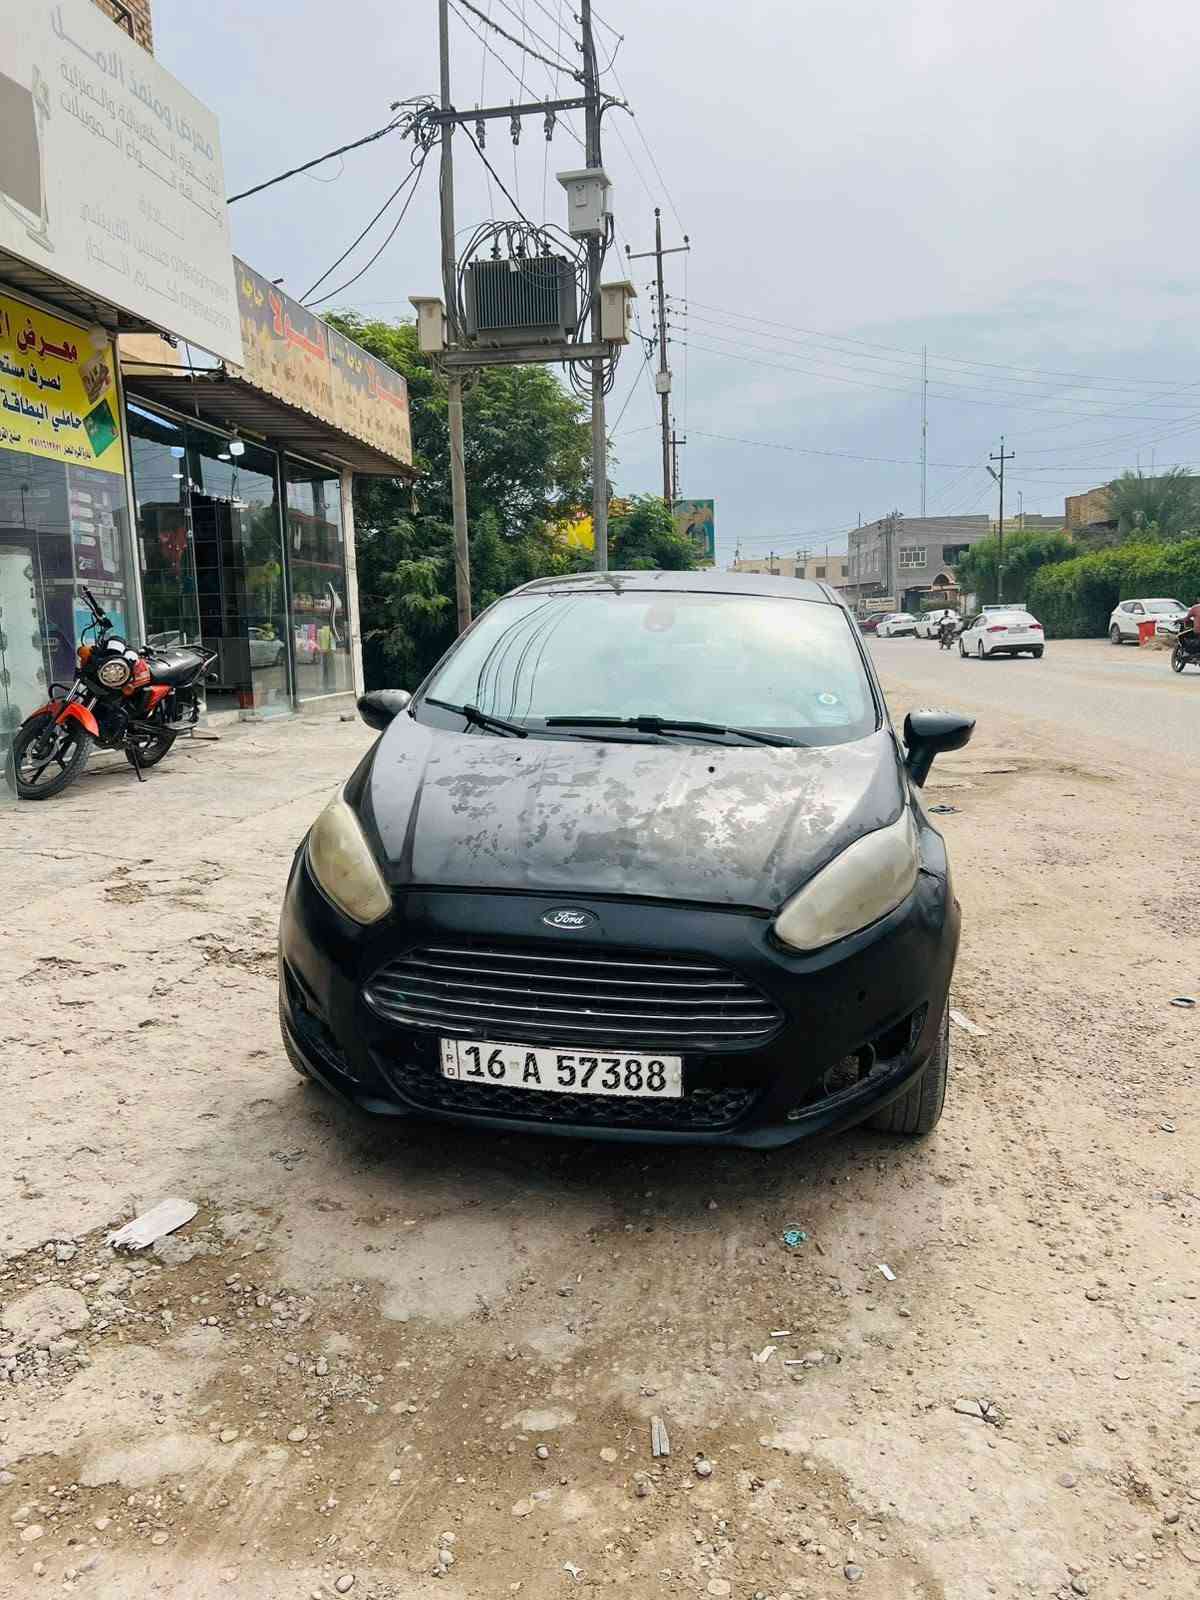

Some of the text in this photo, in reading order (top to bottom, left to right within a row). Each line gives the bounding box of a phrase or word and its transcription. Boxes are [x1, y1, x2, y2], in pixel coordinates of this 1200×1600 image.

[17, 317, 78, 361] معرض
[28, 363, 61, 390] لصرف
[0, 389, 82, 432] حاملي البطاقة
[553, 910, 585, 924] Ford
[465, 1046, 668, 1092] 16 A 57388
